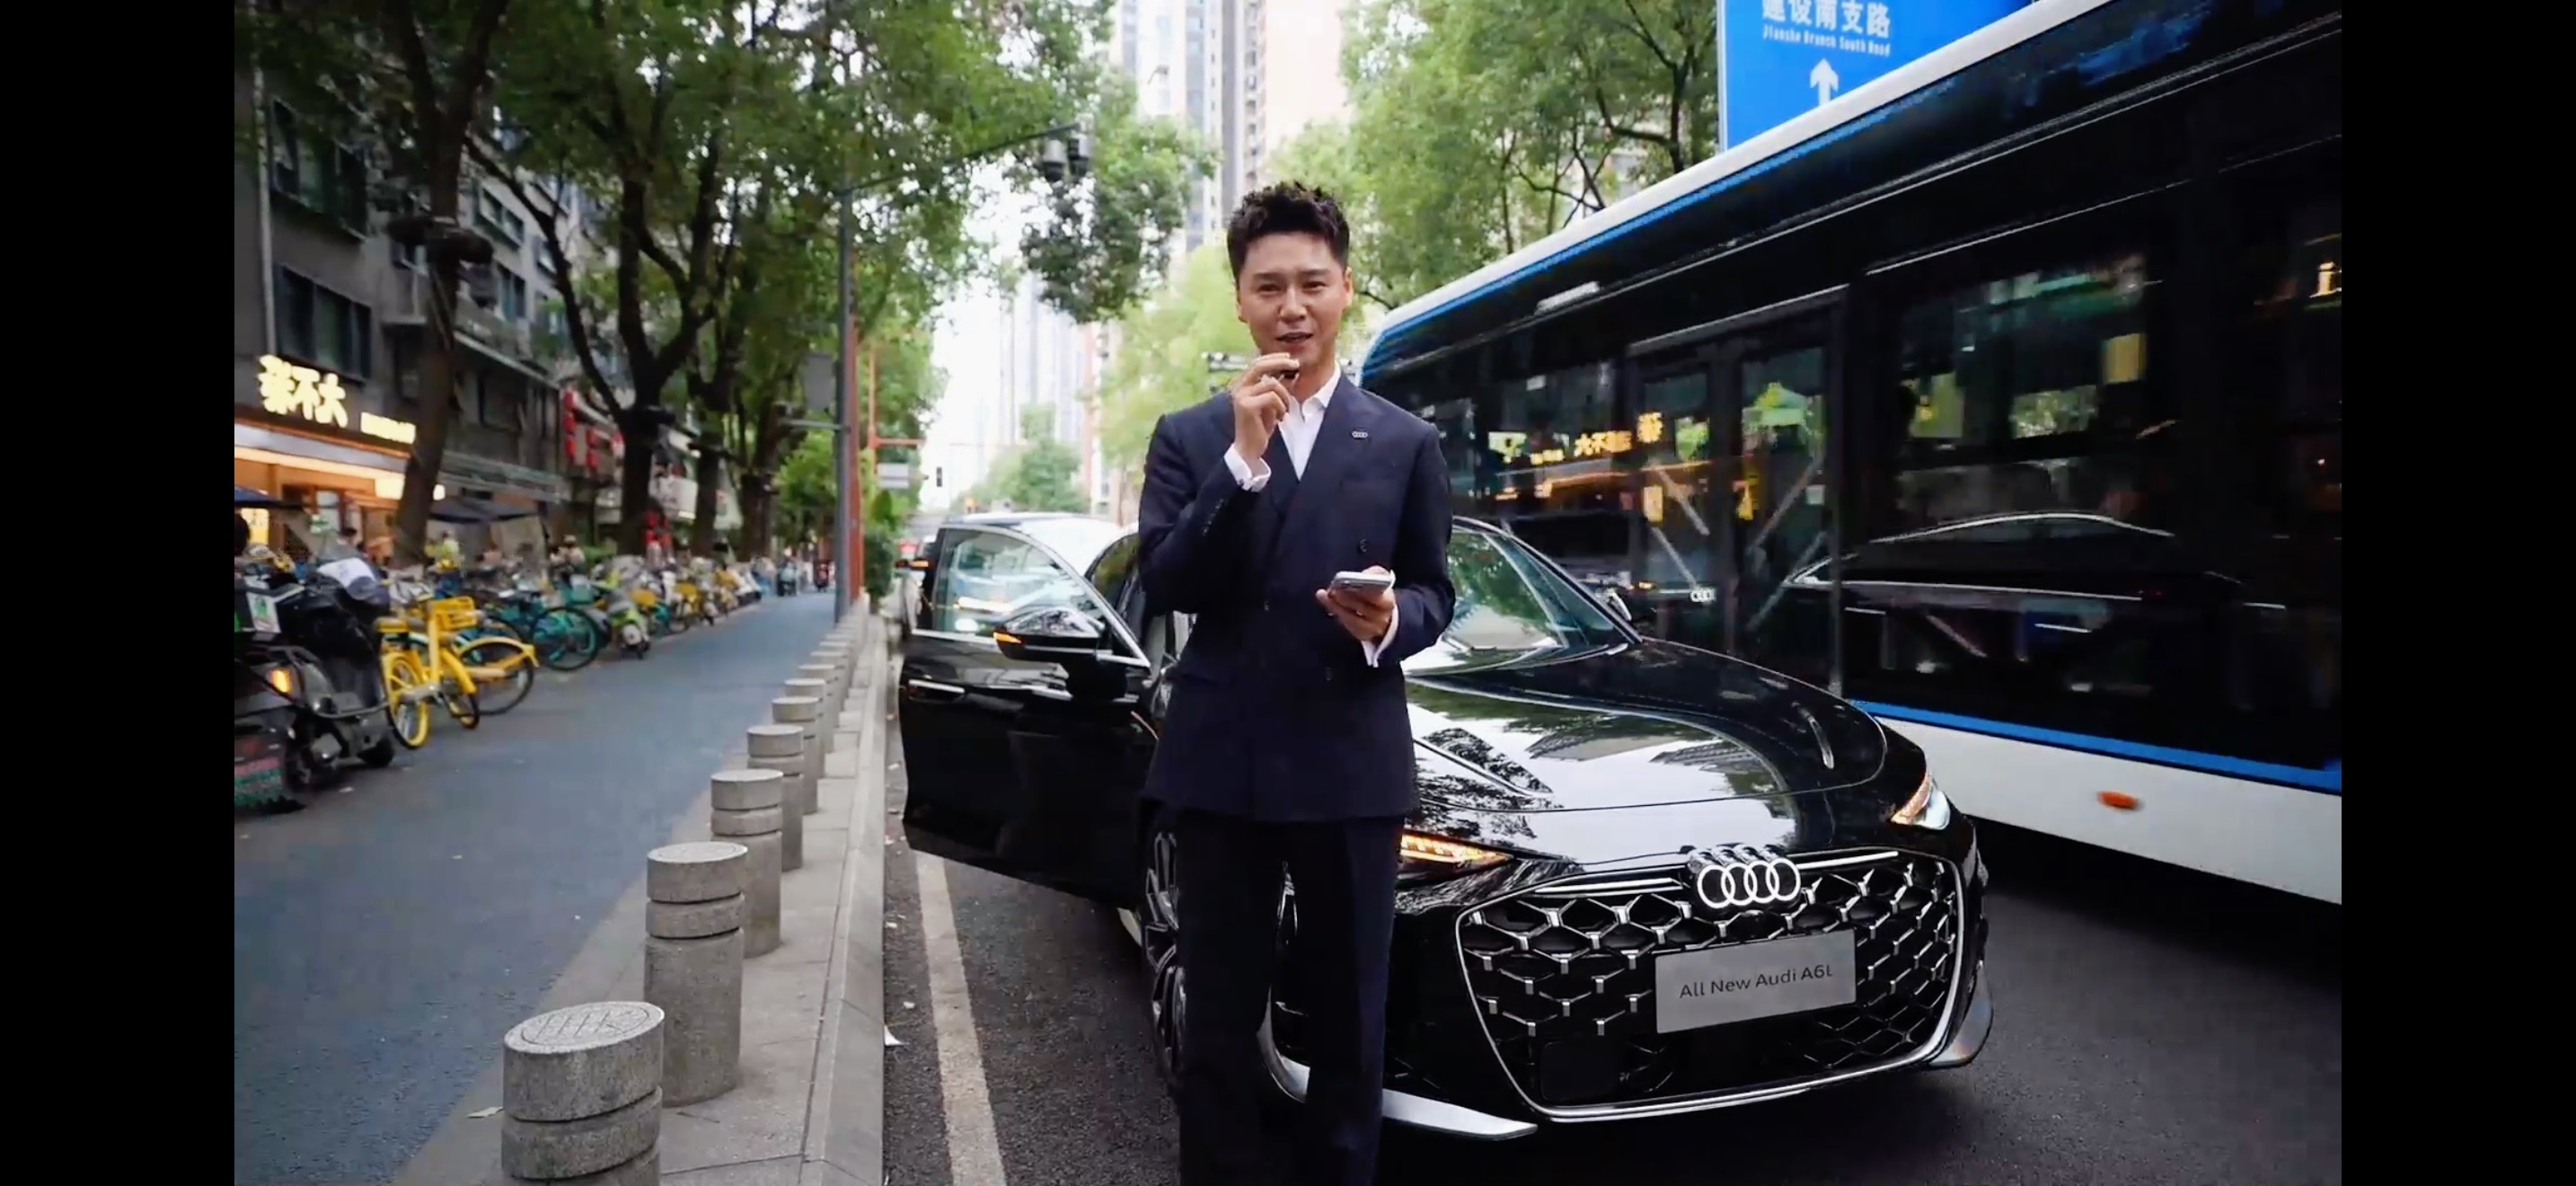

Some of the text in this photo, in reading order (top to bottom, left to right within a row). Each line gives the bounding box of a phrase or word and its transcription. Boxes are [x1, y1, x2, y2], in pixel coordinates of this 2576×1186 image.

[1762, 0, 1891, 39] 建设南支路
[1839, 36, 1866, 52] South
[1679, 964, 1833, 999] All New Audi A6L
